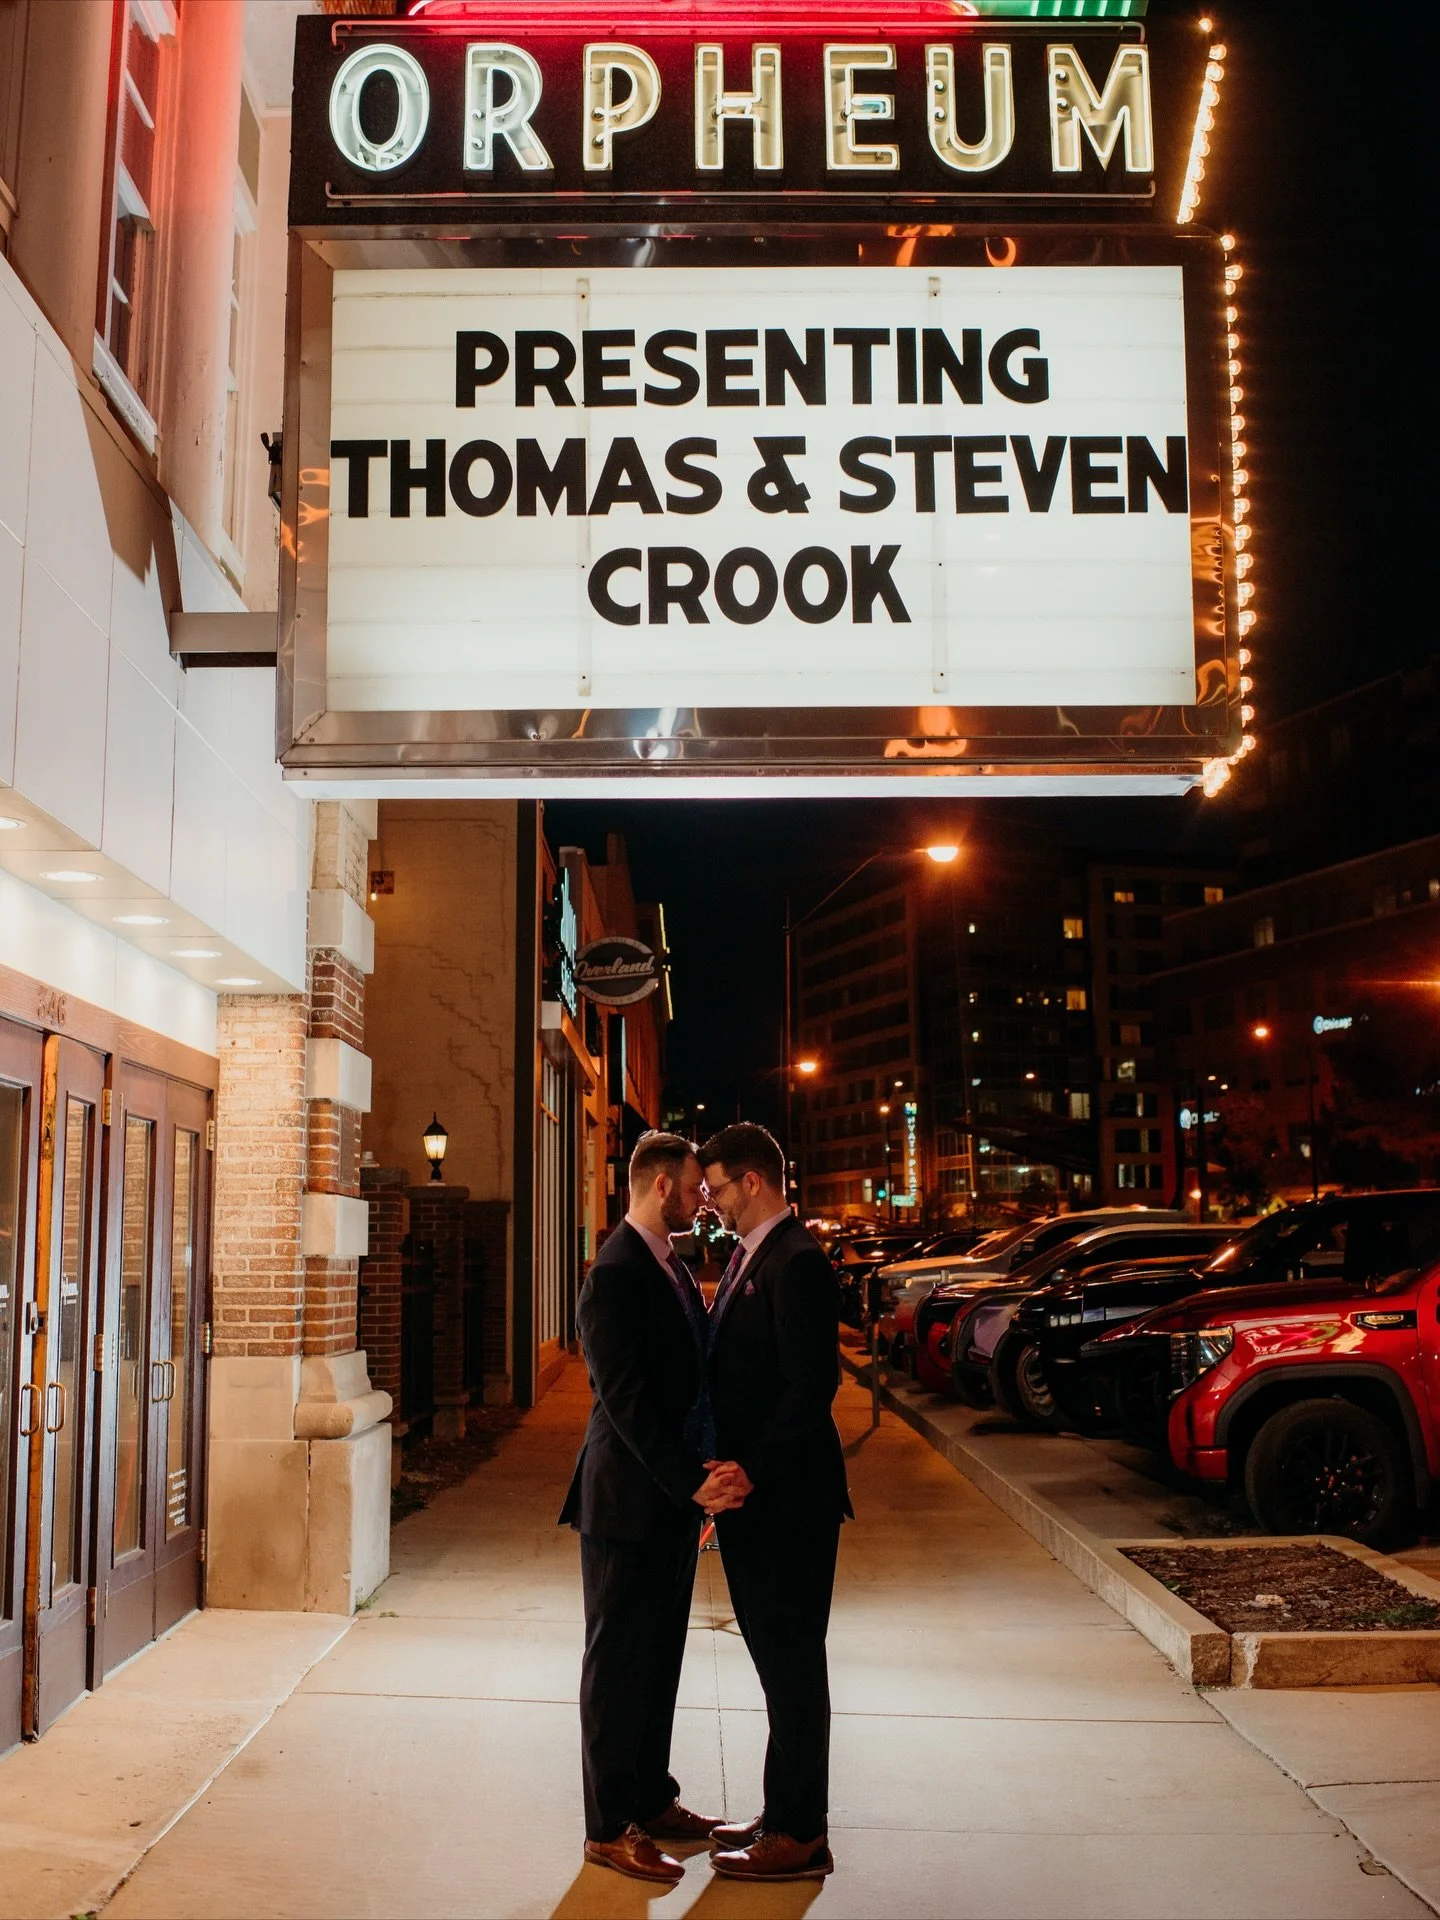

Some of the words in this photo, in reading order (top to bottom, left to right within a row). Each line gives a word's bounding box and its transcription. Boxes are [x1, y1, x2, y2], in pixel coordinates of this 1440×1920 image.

[328, 42, 1155, 173] ORPHEUM
[456, 327, 1049, 408] PRESENTING
[331, 436, 722, 518] THOMAS
[747, 435, 812, 514] &
[839, 434, 1189, 514] STEVEN
[588, 544, 911, 626] CROOK
[38, 985, 68, 1028] 346
[574, 956, 655, 979] Overland
[907, 1116, 917, 1157] HYATT
